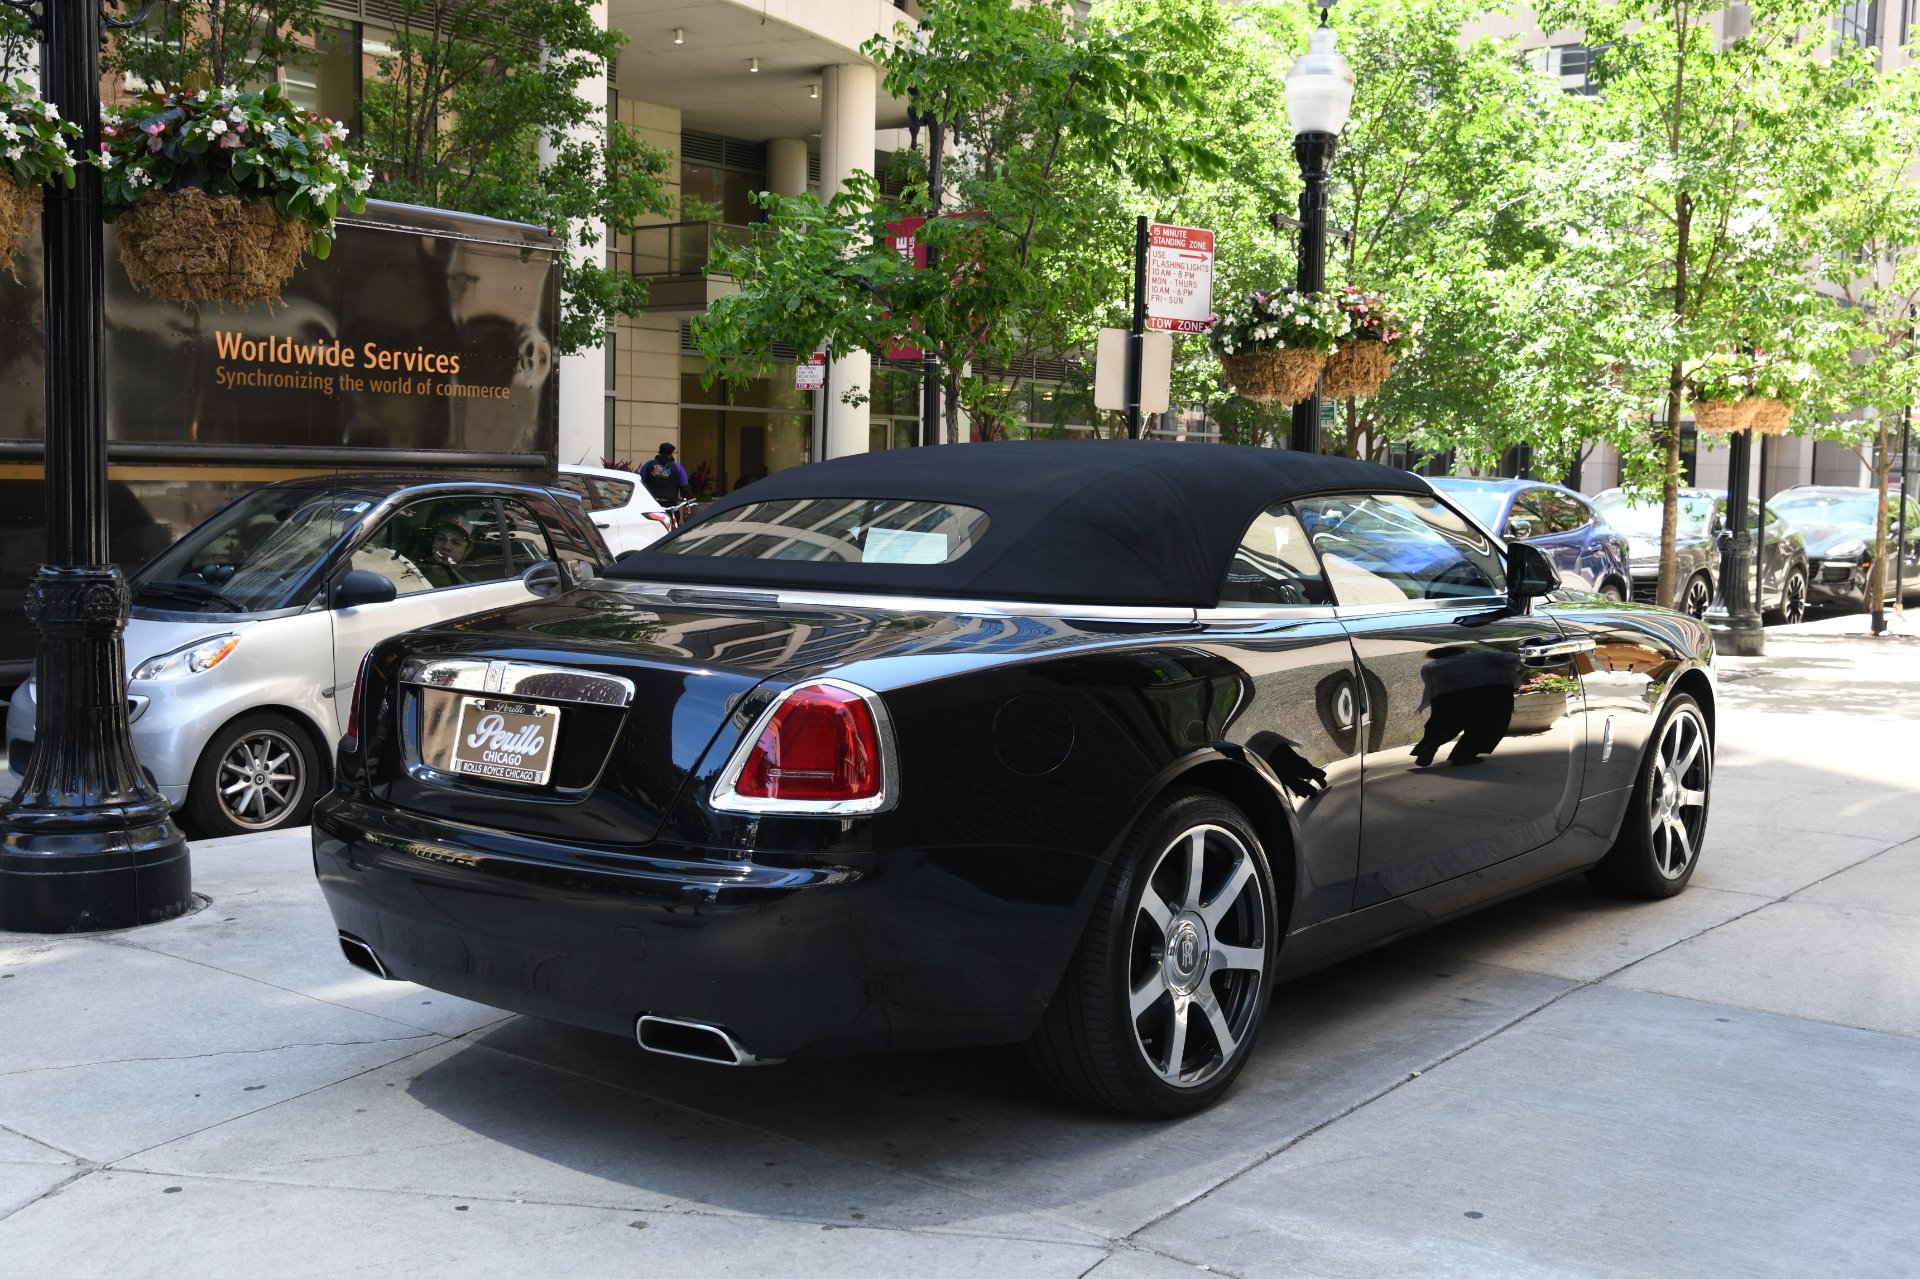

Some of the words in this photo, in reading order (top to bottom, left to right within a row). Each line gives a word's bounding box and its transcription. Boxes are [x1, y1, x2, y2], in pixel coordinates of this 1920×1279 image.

[1153, 227, 1161, 236] 15
[1163, 228, 1188, 239] MINUTE
[1153, 236, 1186, 247] STANDING
[1189, 241, 1207, 249] ZONE
[1152, 251, 1166, 259] USE
[1152, 260, 1185, 270] FLASHING
[1186, 263, 1209, 272] LIGHTS
[1160, 269, 1171, 277] AM
[1152, 277, 1167, 285] MON
[1175, 279, 1198, 288] THURS
[1151, 294, 1162, 302] FRI
[1169, 296, 1184, 304] SUN
[1150, 318, 1173, 329] TOW
[1178, 320, 1206, 332] ZONE
[215, 330, 356, 368] Worldwide
[363, 342, 460, 374] Services
[215, 366, 334, 395] Synchronizing
[339, 374, 364, 392] the
[370, 377, 412, 395] world
[417, 378, 431, 396] of
[436, 381, 510, 400] commerce
[494, 702, 526, 714] Perillo
[467, 714, 545, 756] Perillo
[482, 750, 522, 766] CHICAGO
[463, 763, 482, 773] ROLLS
[483, 765, 504, 776] ROYCE
[505, 768, 534, 780] CHICAGO
